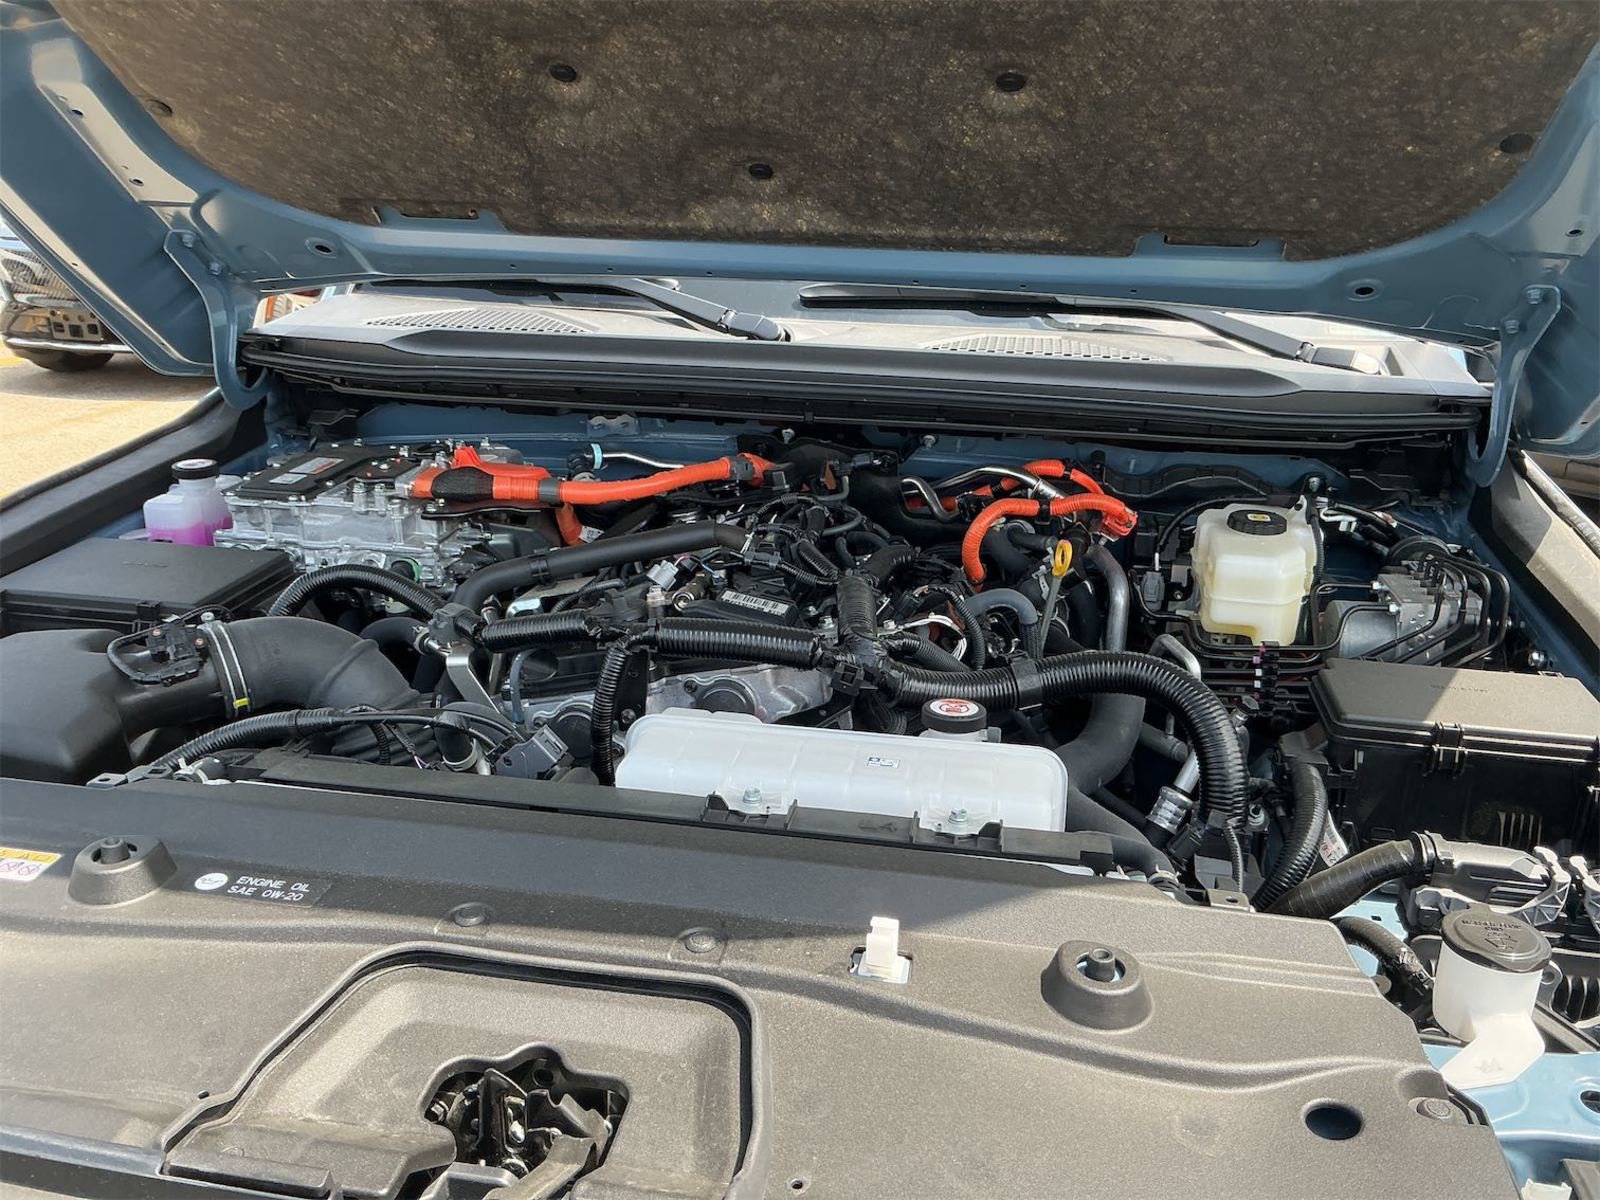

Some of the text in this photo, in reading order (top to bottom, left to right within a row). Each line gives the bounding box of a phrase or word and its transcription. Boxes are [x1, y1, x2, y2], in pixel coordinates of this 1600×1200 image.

[236, 875, 310, 892] ENGINE OIL
[227, 885, 304, 901] SAE 0W-20
